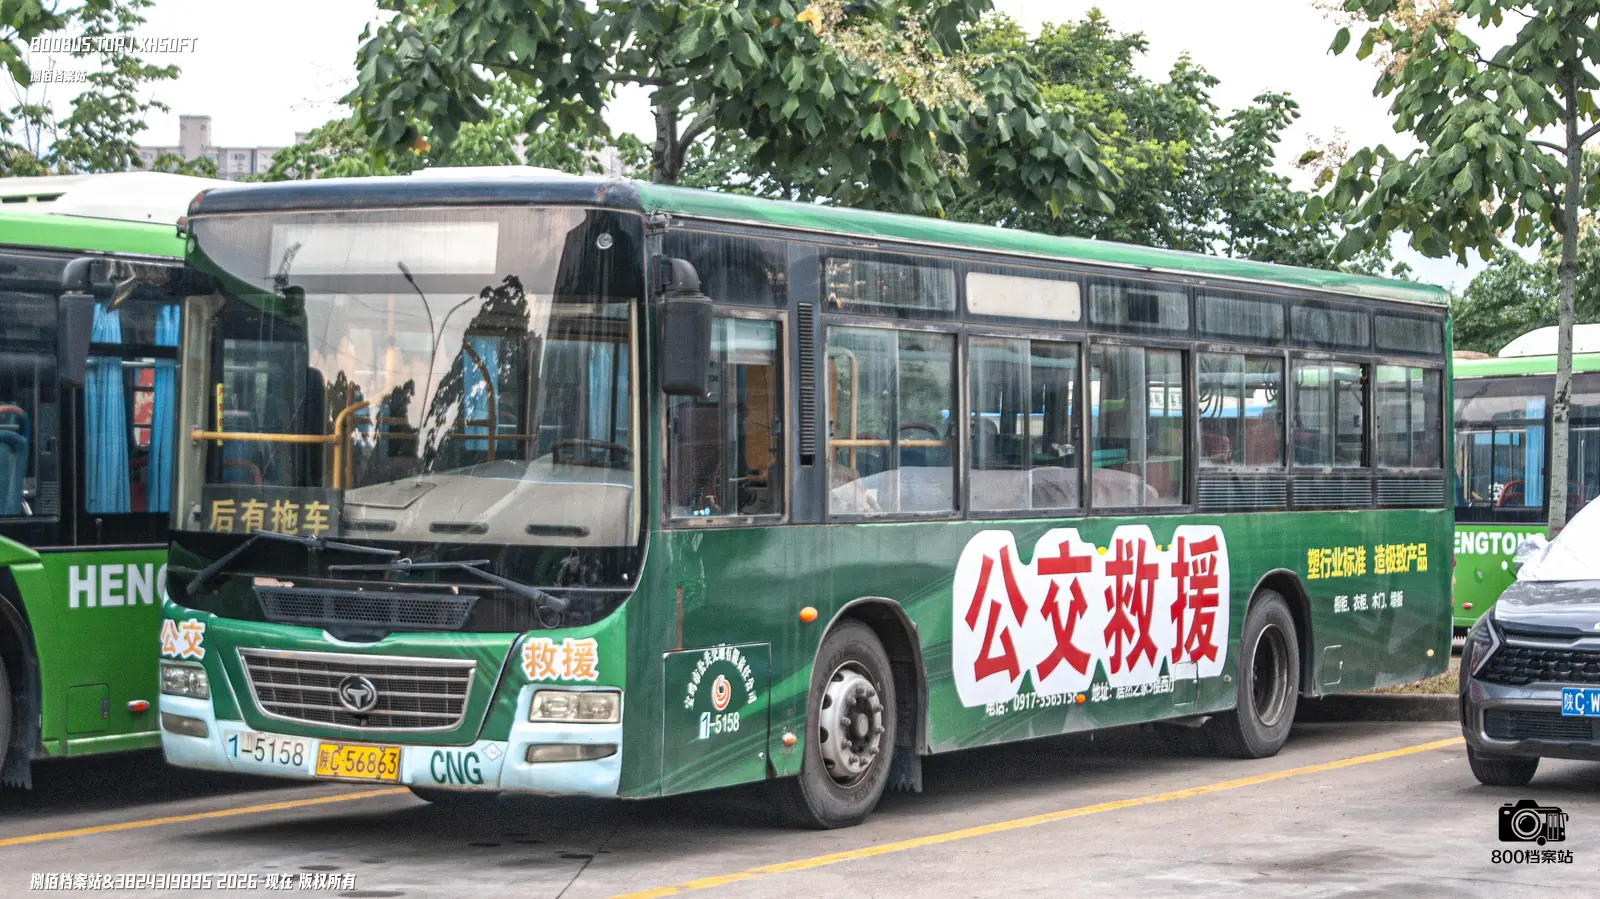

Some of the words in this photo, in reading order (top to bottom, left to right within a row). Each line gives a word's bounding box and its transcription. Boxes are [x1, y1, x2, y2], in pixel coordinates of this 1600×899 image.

[209, 499, 331, 534] 后有拖车
[1307, 545, 1367, 580] 塑行业标准
[1373, 542, 1428, 575] 造极致产品
[964, 534, 1221, 685] 公交救援
[161, 621, 205, 658] 公交
[523, 639, 598, 680] 救援
[698, 711, 740, 740] 1-5158
[228, 734, 304, 767] 1-5158
[430, 749, 485, 785] CNG
